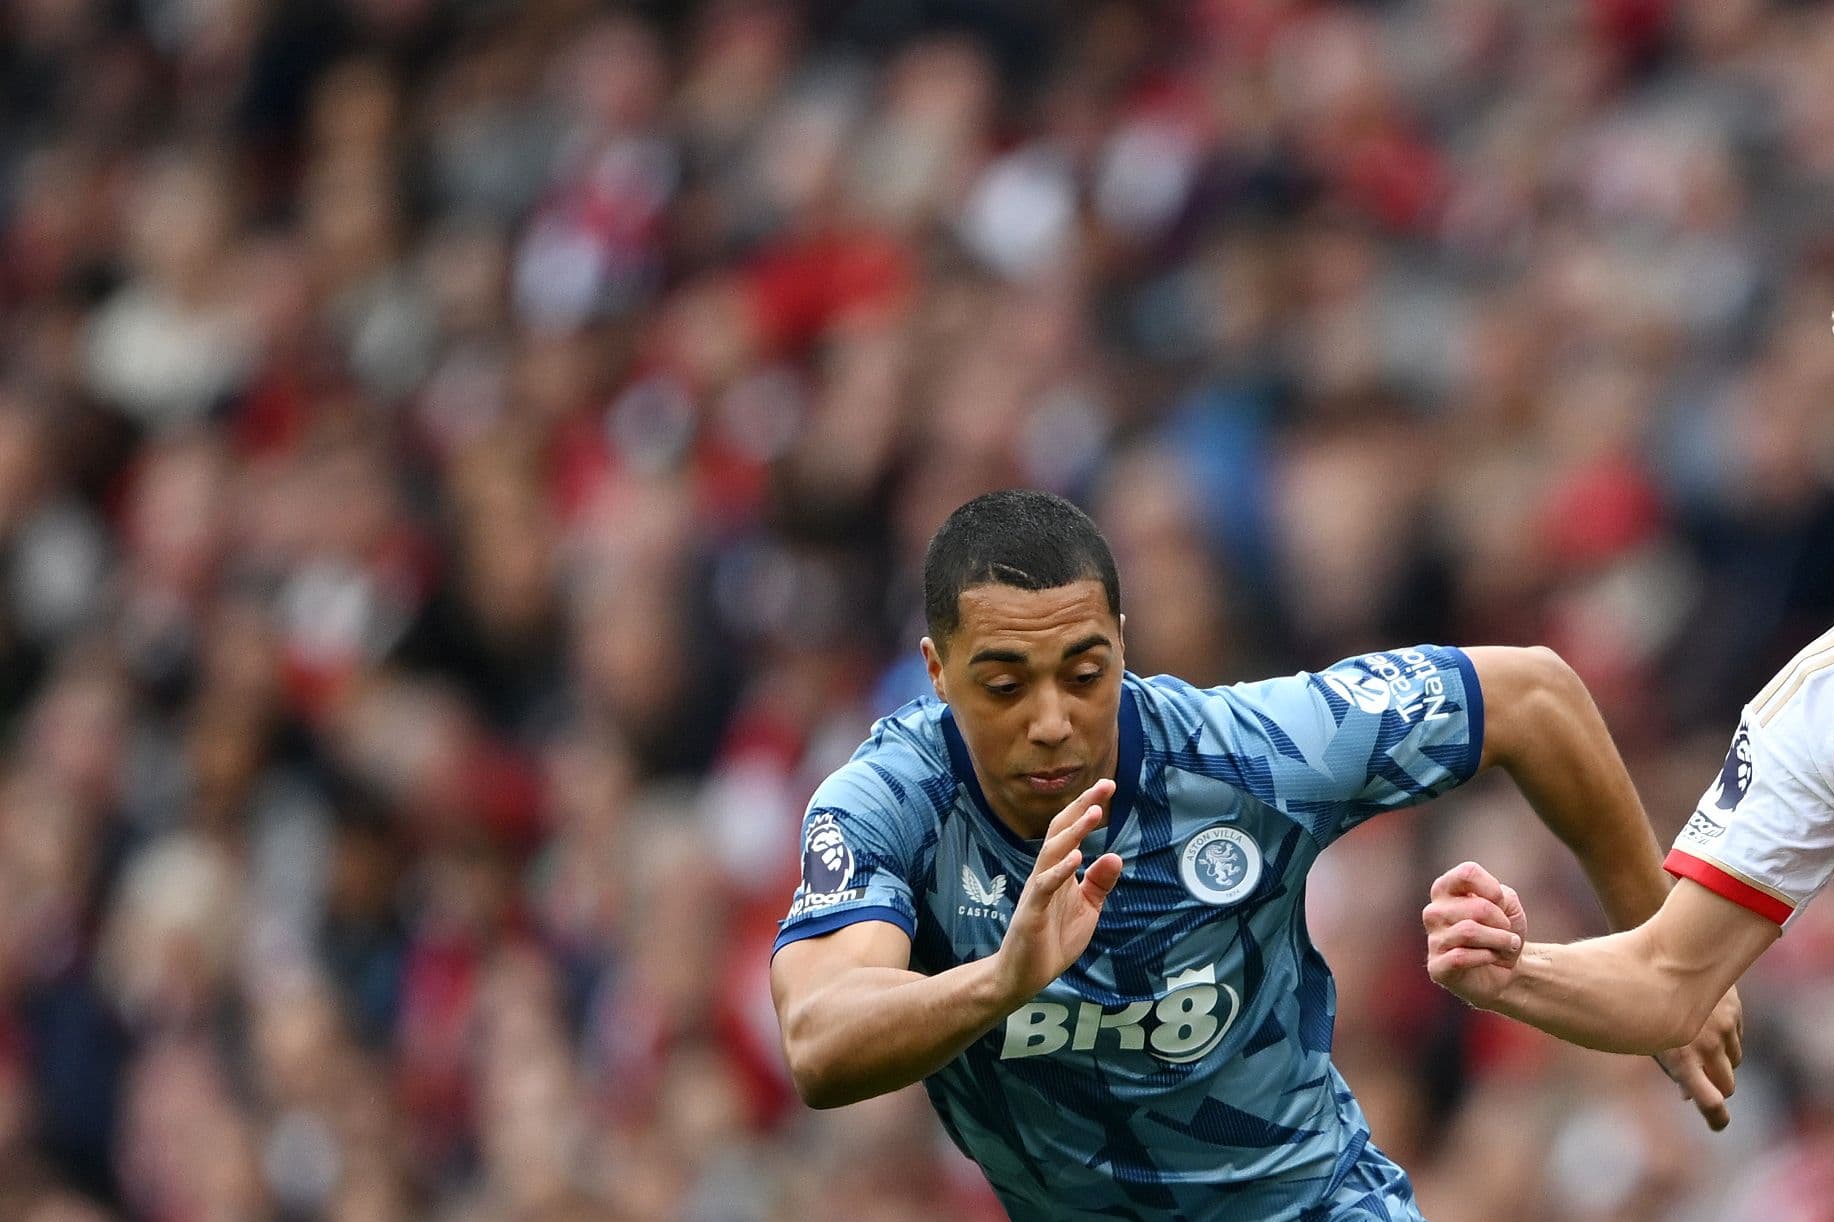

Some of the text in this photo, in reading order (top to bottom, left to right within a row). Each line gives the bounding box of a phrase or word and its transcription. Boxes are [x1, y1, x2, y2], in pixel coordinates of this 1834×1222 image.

[1402, 649, 1449, 722] Natio
[1186, 829, 1243, 862] ASTON VILLA
[804, 889, 857, 907] room
